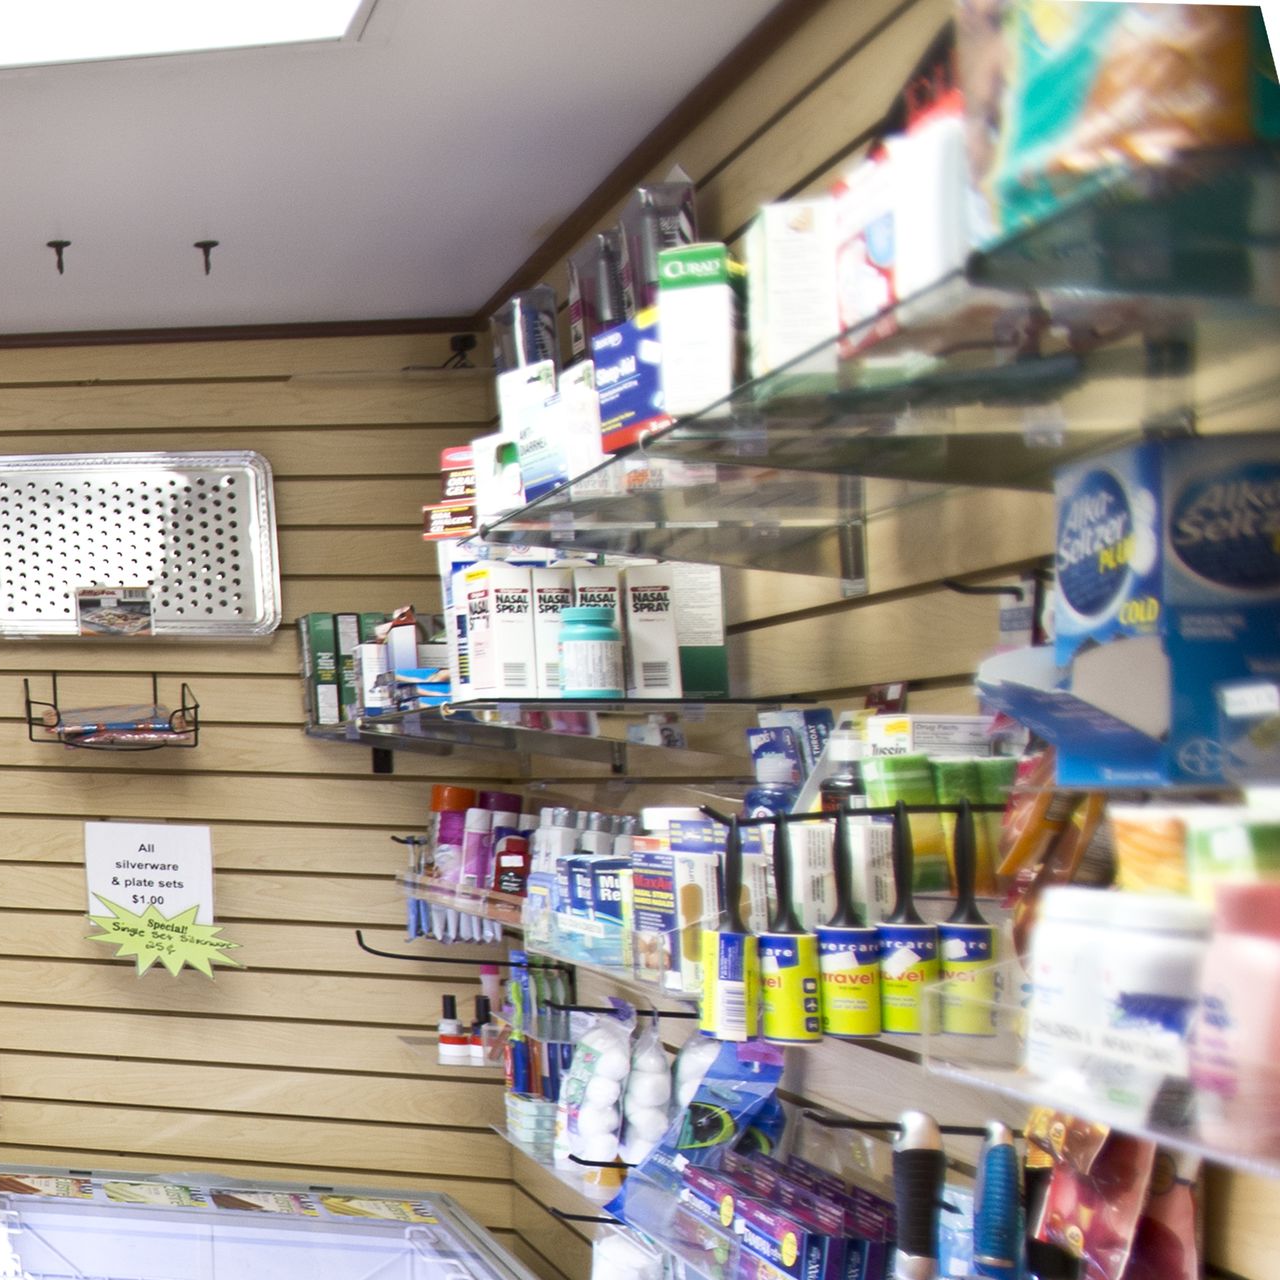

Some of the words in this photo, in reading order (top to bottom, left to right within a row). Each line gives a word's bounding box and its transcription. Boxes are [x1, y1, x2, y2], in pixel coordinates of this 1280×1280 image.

[664, 257, 722, 278] CURAD
[495, 595, 527, 604] NASAL
[538, 595, 570, 604] NASAL
[580, 593, 615, 604] NASAL
[632, 592, 670, 602] NASAL
[496, 604, 528, 614] SPRAY
[633, 602, 669, 613] SPRAY
[1120, 597, 1160, 625] COLD
[138, 843, 155, 853] All
[115, 860, 180, 872] silverware
[111, 876, 121, 886] &
[124, 877, 155, 888] plate
[158, 880, 184, 889] sets
[132, 894, 165, 905] $1.00
[112, 922, 145, 938] Single
[146, 918, 189, 935] Special!
